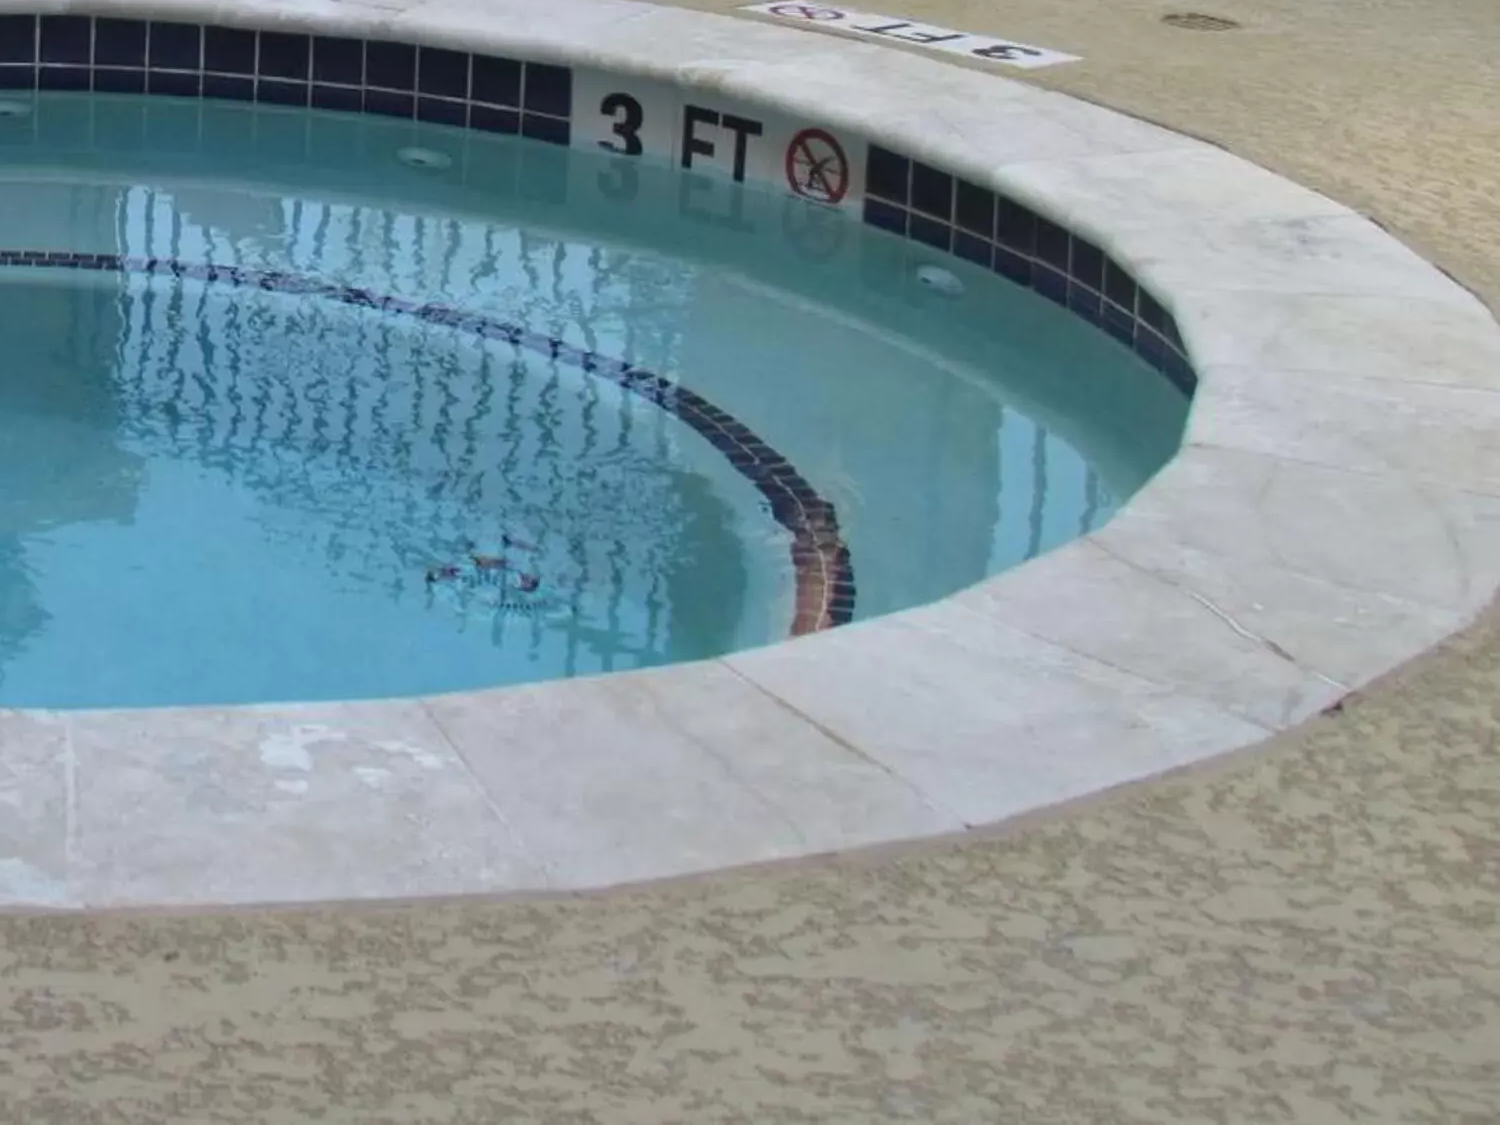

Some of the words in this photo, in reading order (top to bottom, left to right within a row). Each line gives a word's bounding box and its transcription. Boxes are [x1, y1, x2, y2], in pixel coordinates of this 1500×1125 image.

[851, 23, 967, 44] FT
[972, 45, 1043, 60] 3
[598, 92, 643, 156] 3
[682, 104, 763, 183] FT
